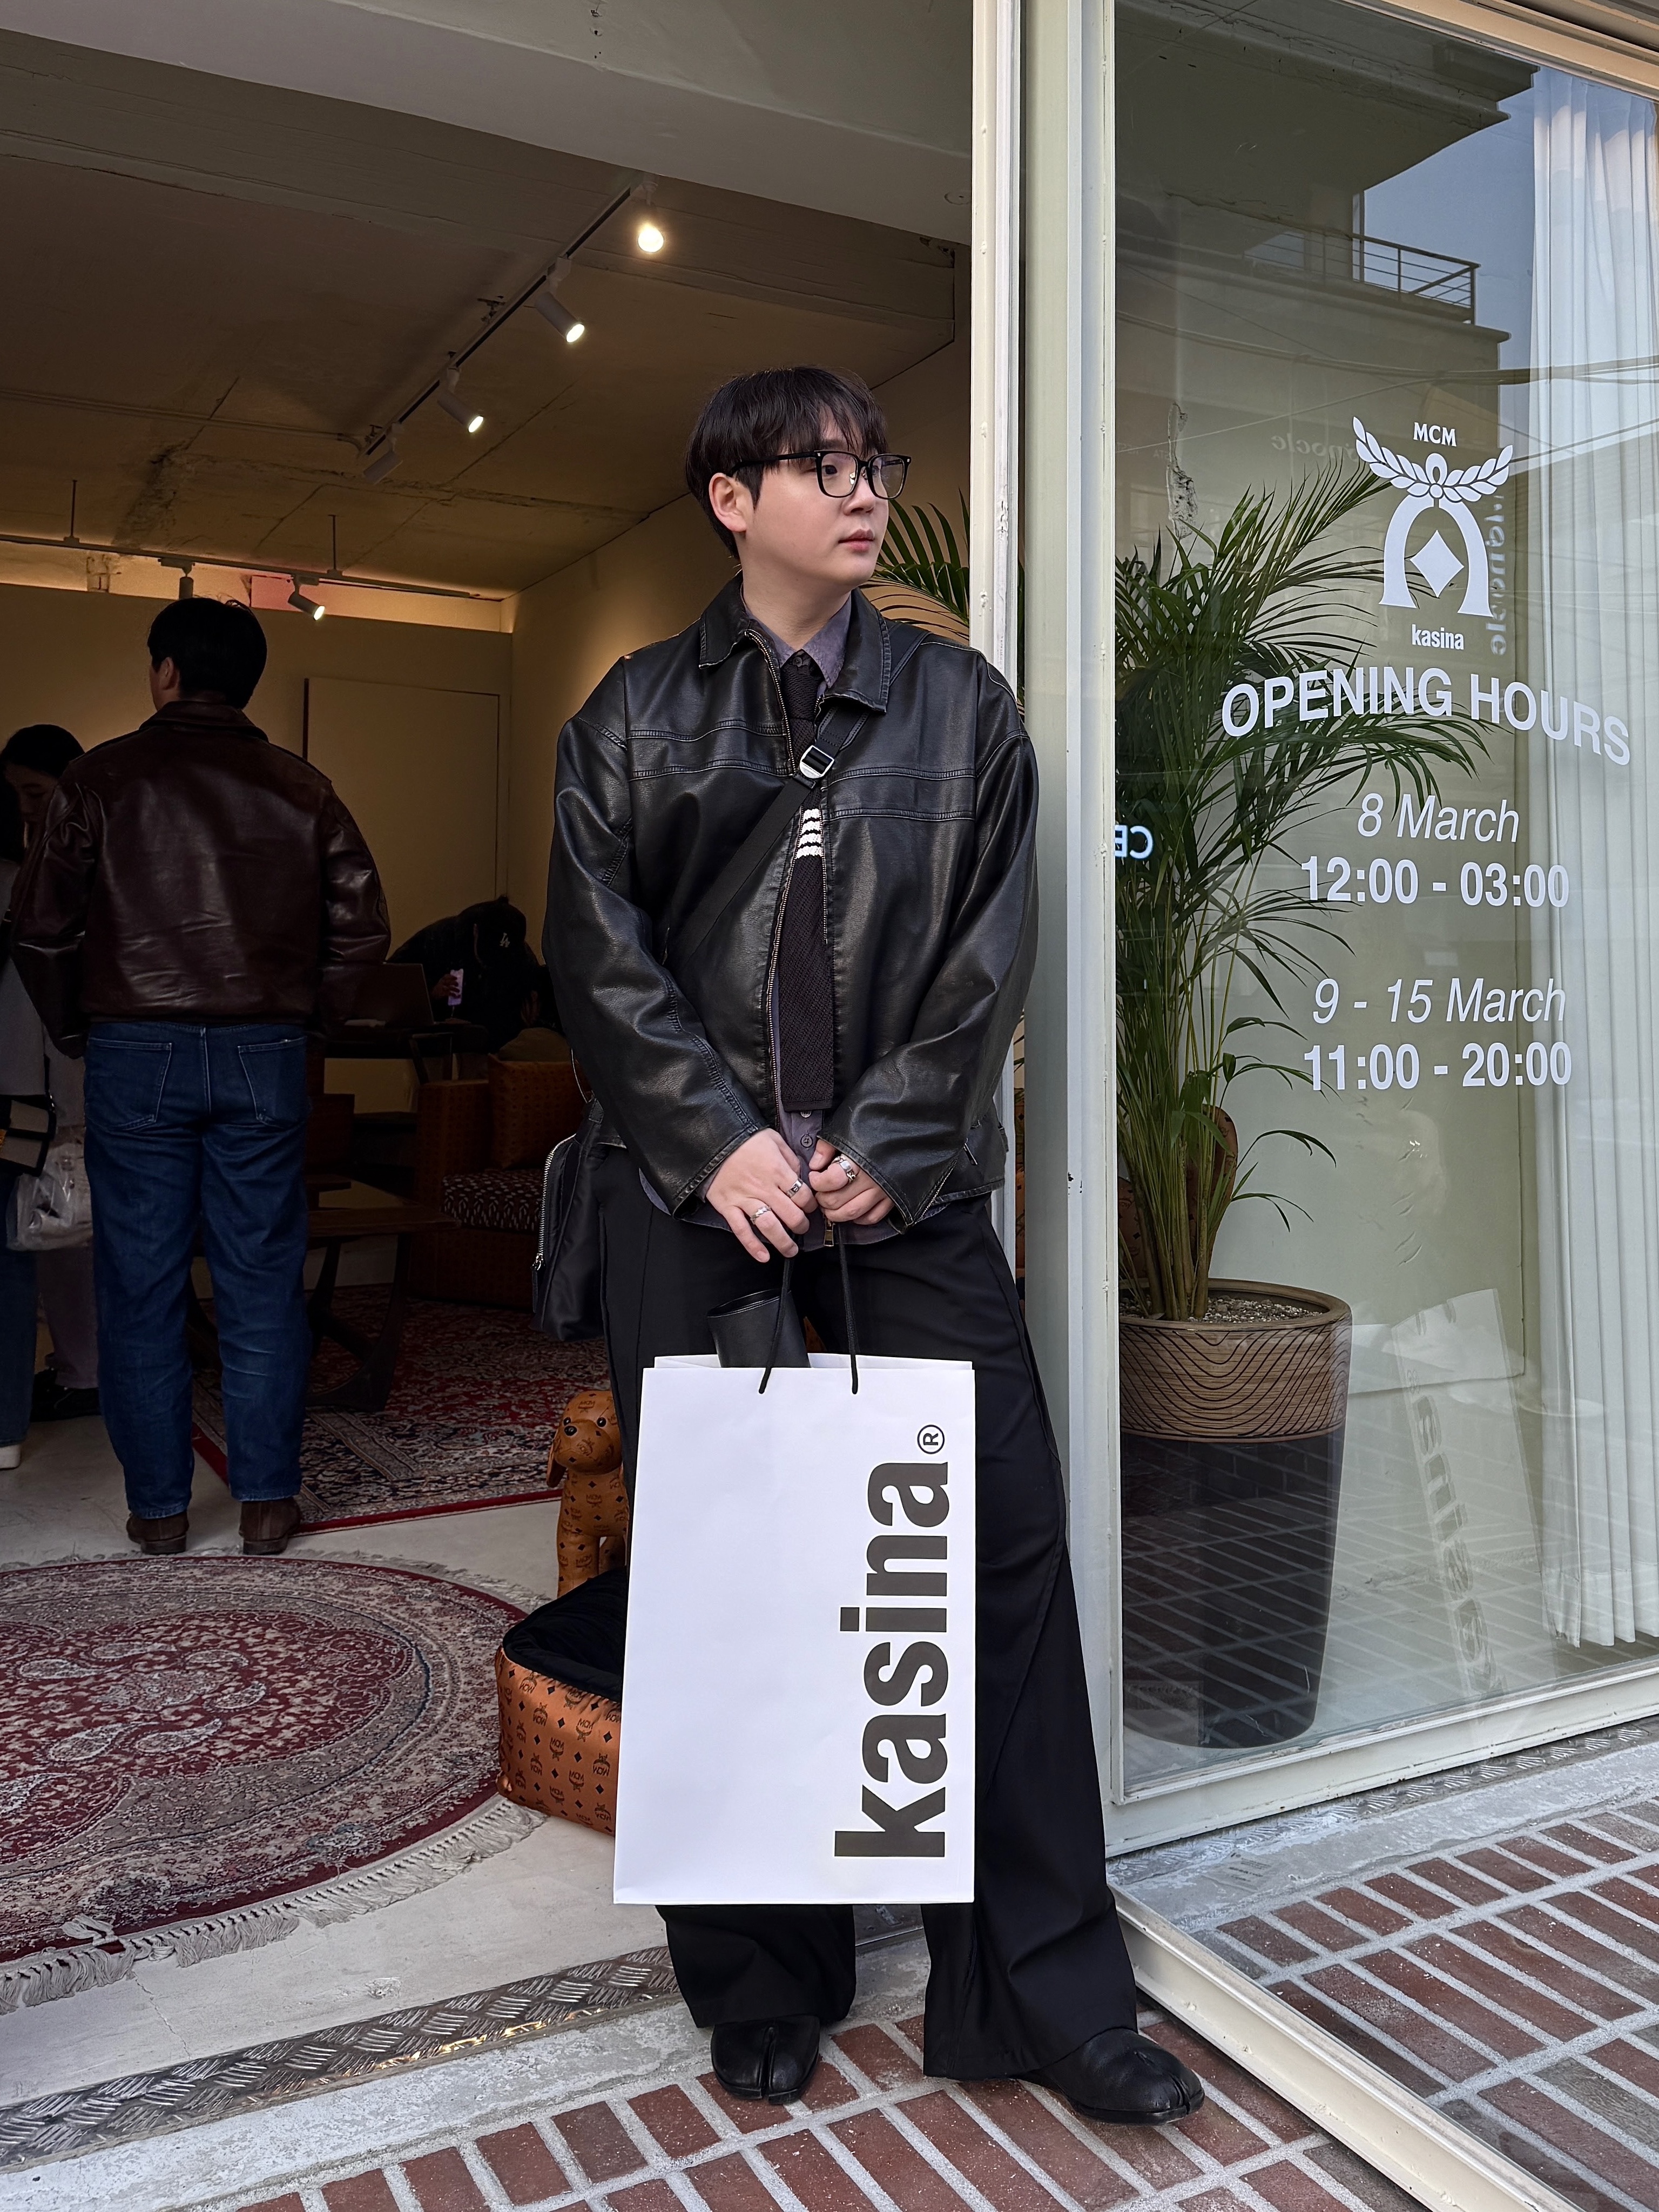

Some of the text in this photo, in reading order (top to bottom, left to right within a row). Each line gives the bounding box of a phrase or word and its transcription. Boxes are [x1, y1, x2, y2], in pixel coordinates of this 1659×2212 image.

[1413, 422, 1457, 447] MCM
[1412, 624, 1464, 650] kasina
[1222, 666, 1630, 766] OPENING HOURS
[1357, 793, 1520, 843] 8 March
[1301, 855, 1569, 907] 12:00 - 03:00
[1313, 978, 1339, 1024] 9
[1387, 979, 1433, 1023] 15
[1446, 977, 1566, 1022] March
[1304, 1042, 1572, 1091] 11:00 - 20:00
